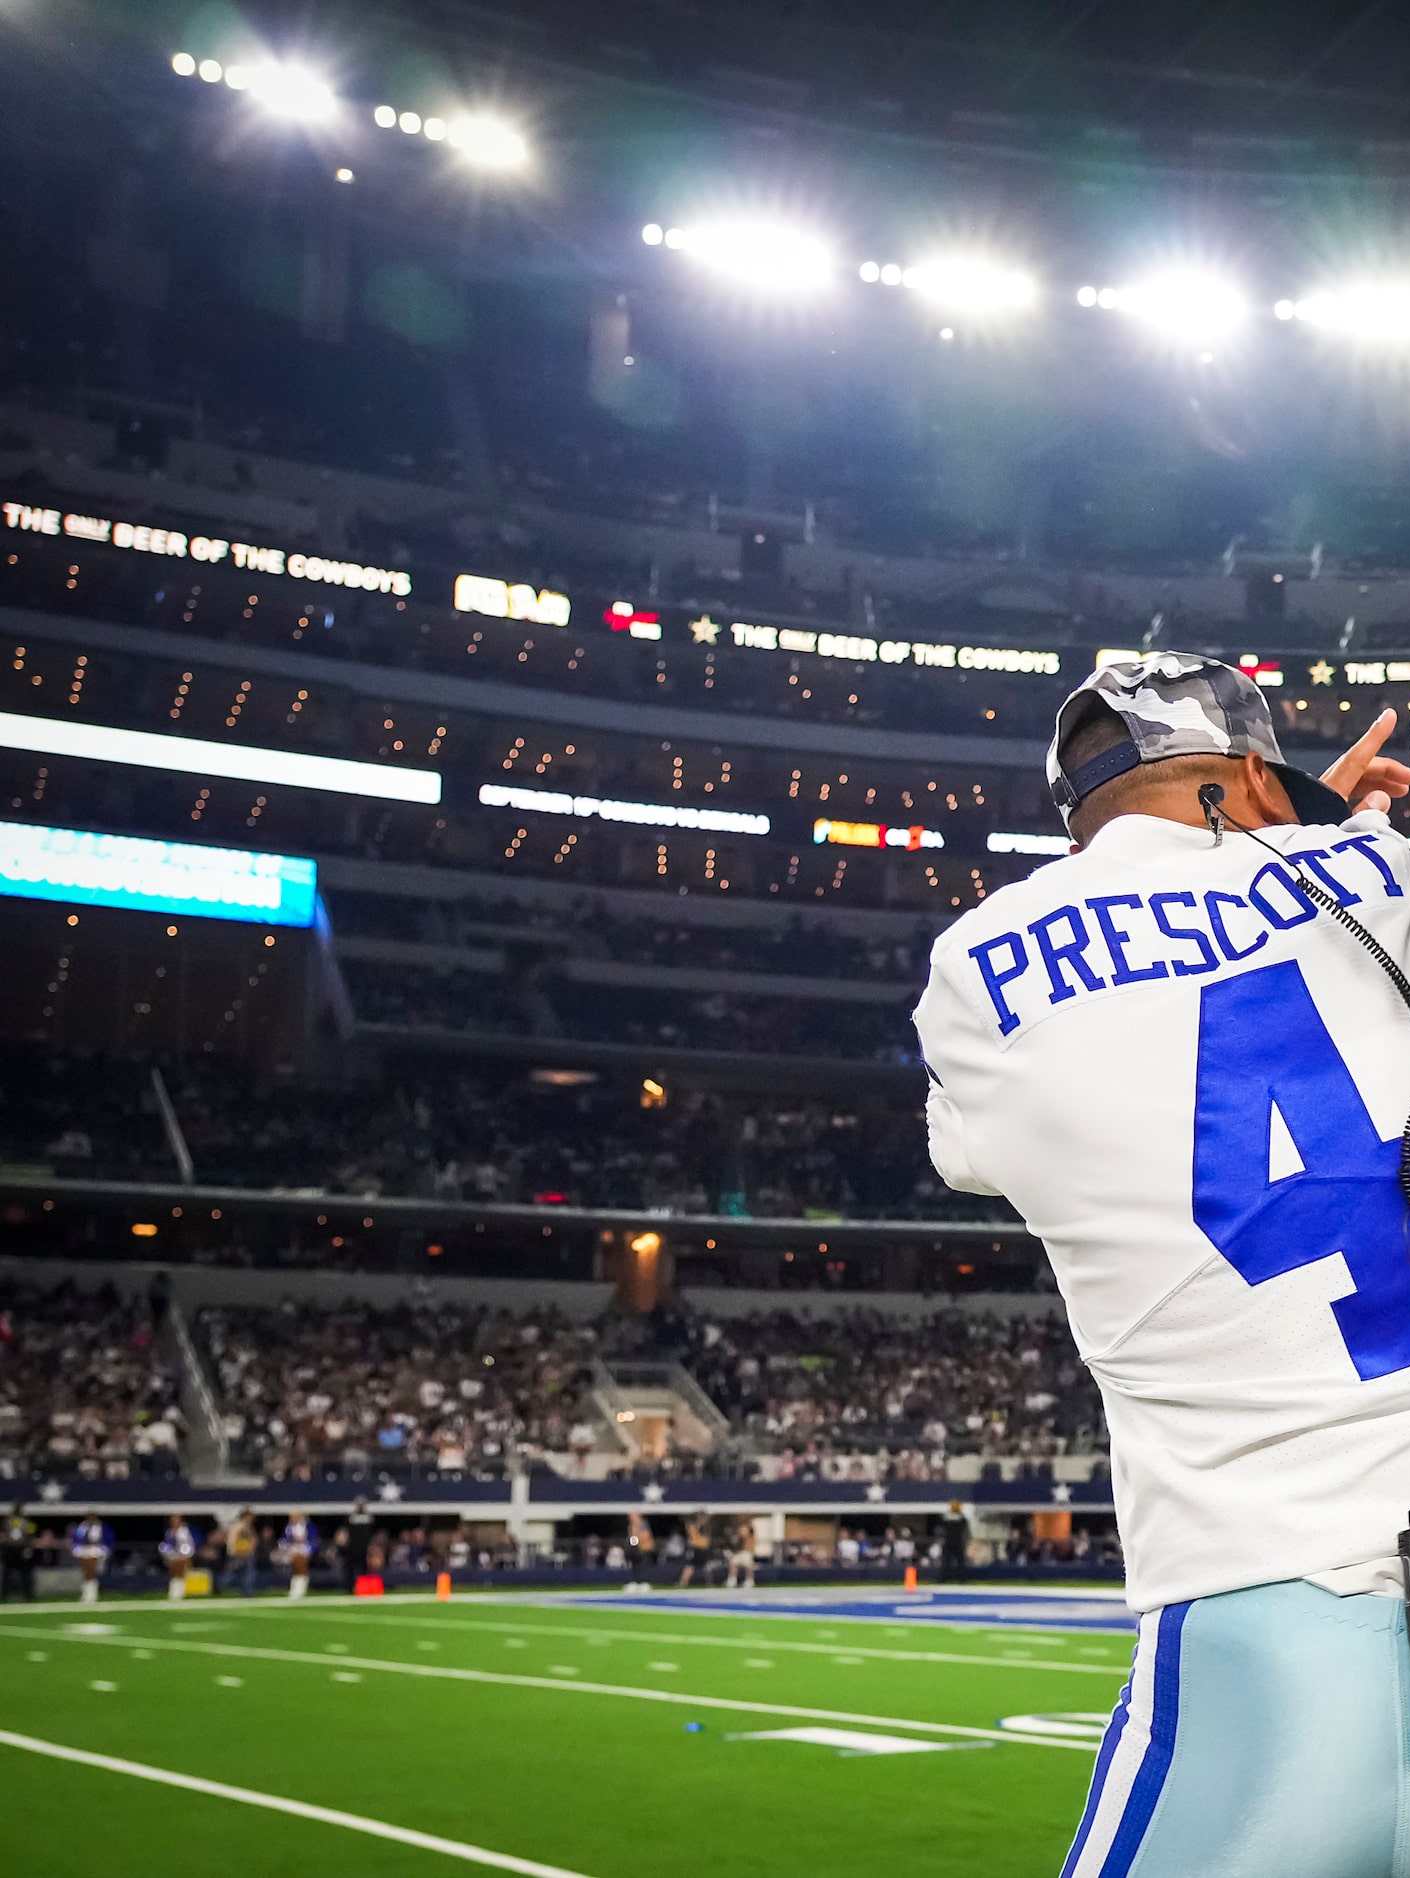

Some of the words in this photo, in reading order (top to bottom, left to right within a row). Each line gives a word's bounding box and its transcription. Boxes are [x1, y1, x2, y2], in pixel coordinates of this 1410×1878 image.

[2, 501, 62, 536] THE
[112, 521, 188, 557] BEER
[190, 536, 229, 563] OF
[230, 542, 286, 575] THE
[287, 553, 412, 597] COWBOYS
[730, 622, 778, 650] THE
[911, 642, 957, 668] THE
[957, 646, 1061, 675] COWBOYS
[968, 834, 1404, 1038] PRESCOTT
